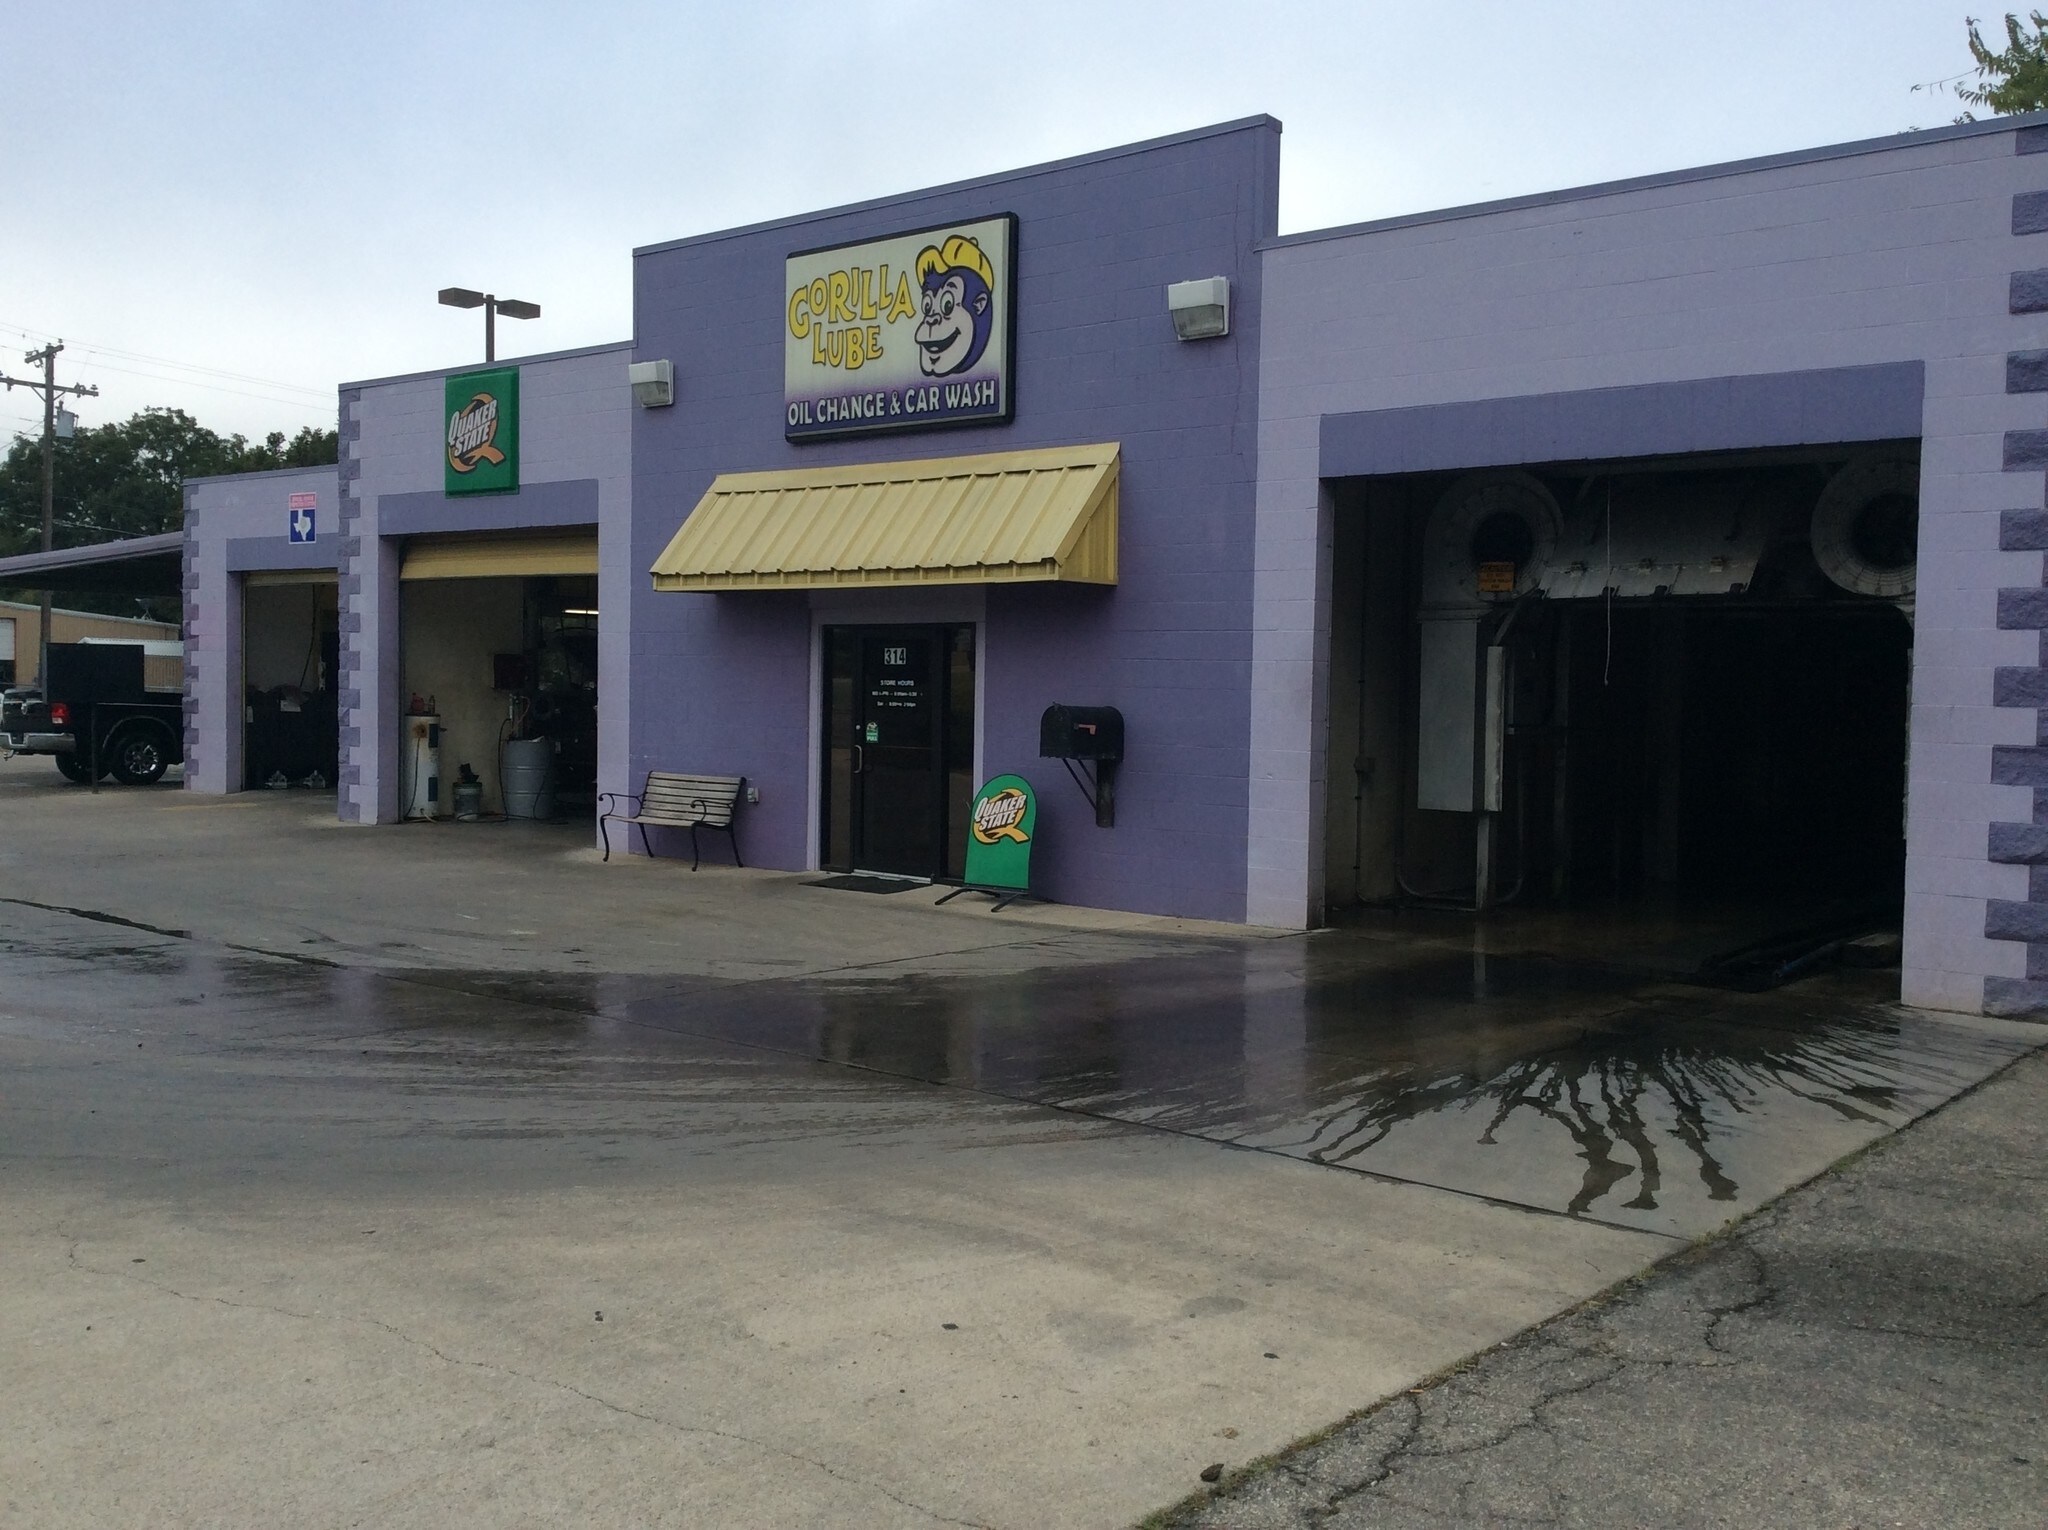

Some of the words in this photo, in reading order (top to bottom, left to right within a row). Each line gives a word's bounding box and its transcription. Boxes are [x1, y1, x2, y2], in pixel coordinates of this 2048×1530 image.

[789, 264, 916, 339] GORILLA
[812, 322, 883, 369] LUBE
[448, 399, 497, 446] QUAKER
[788, 402, 813, 426] OIL
[816, 392, 885, 423] CHANGE
[889, 391, 901, 416] &
[905, 386, 940, 413] CAR
[945, 380, 995, 408] WASH
[454, 421, 490, 457] STATE
[885, 648, 906, 664] 314
[974, 794, 1027, 822] QUAKER
[979, 809, 1018, 831] STATE
